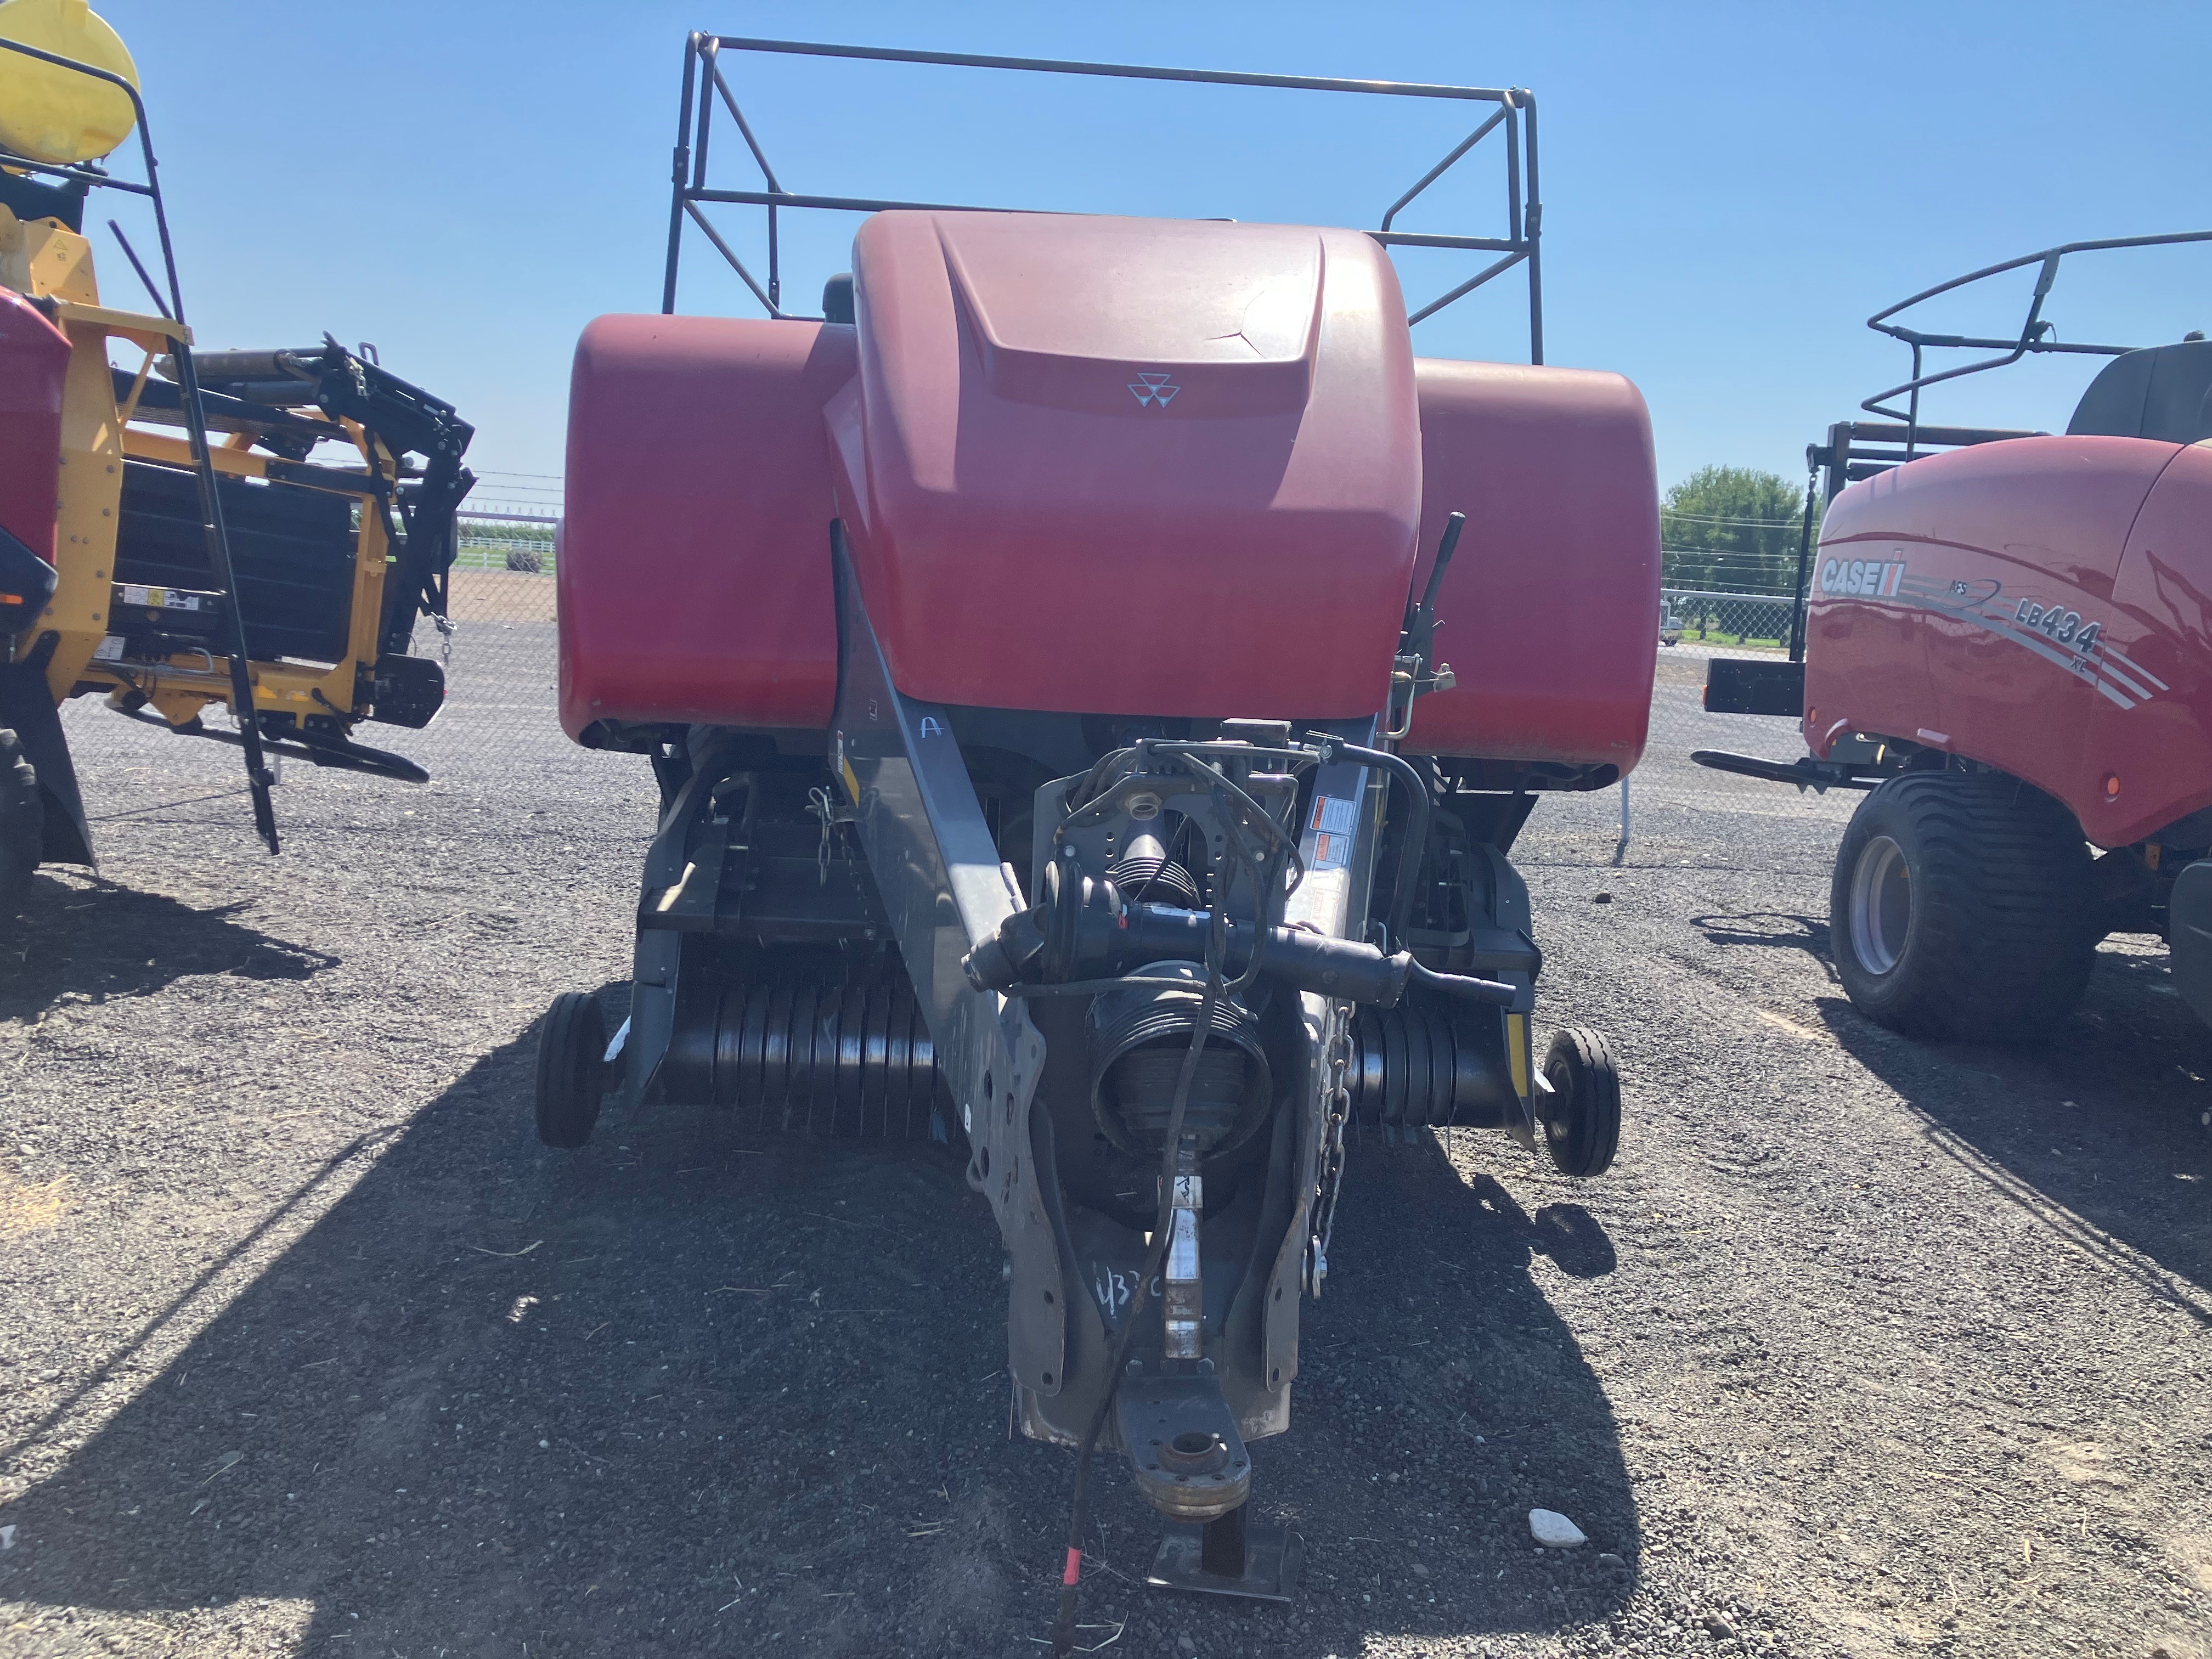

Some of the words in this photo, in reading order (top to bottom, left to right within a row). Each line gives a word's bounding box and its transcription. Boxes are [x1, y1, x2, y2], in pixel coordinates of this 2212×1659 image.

[2015, 597, 2101, 653] LB434
[2070, 655, 2086, 673] XL
[920, 716, 945, 738] A
